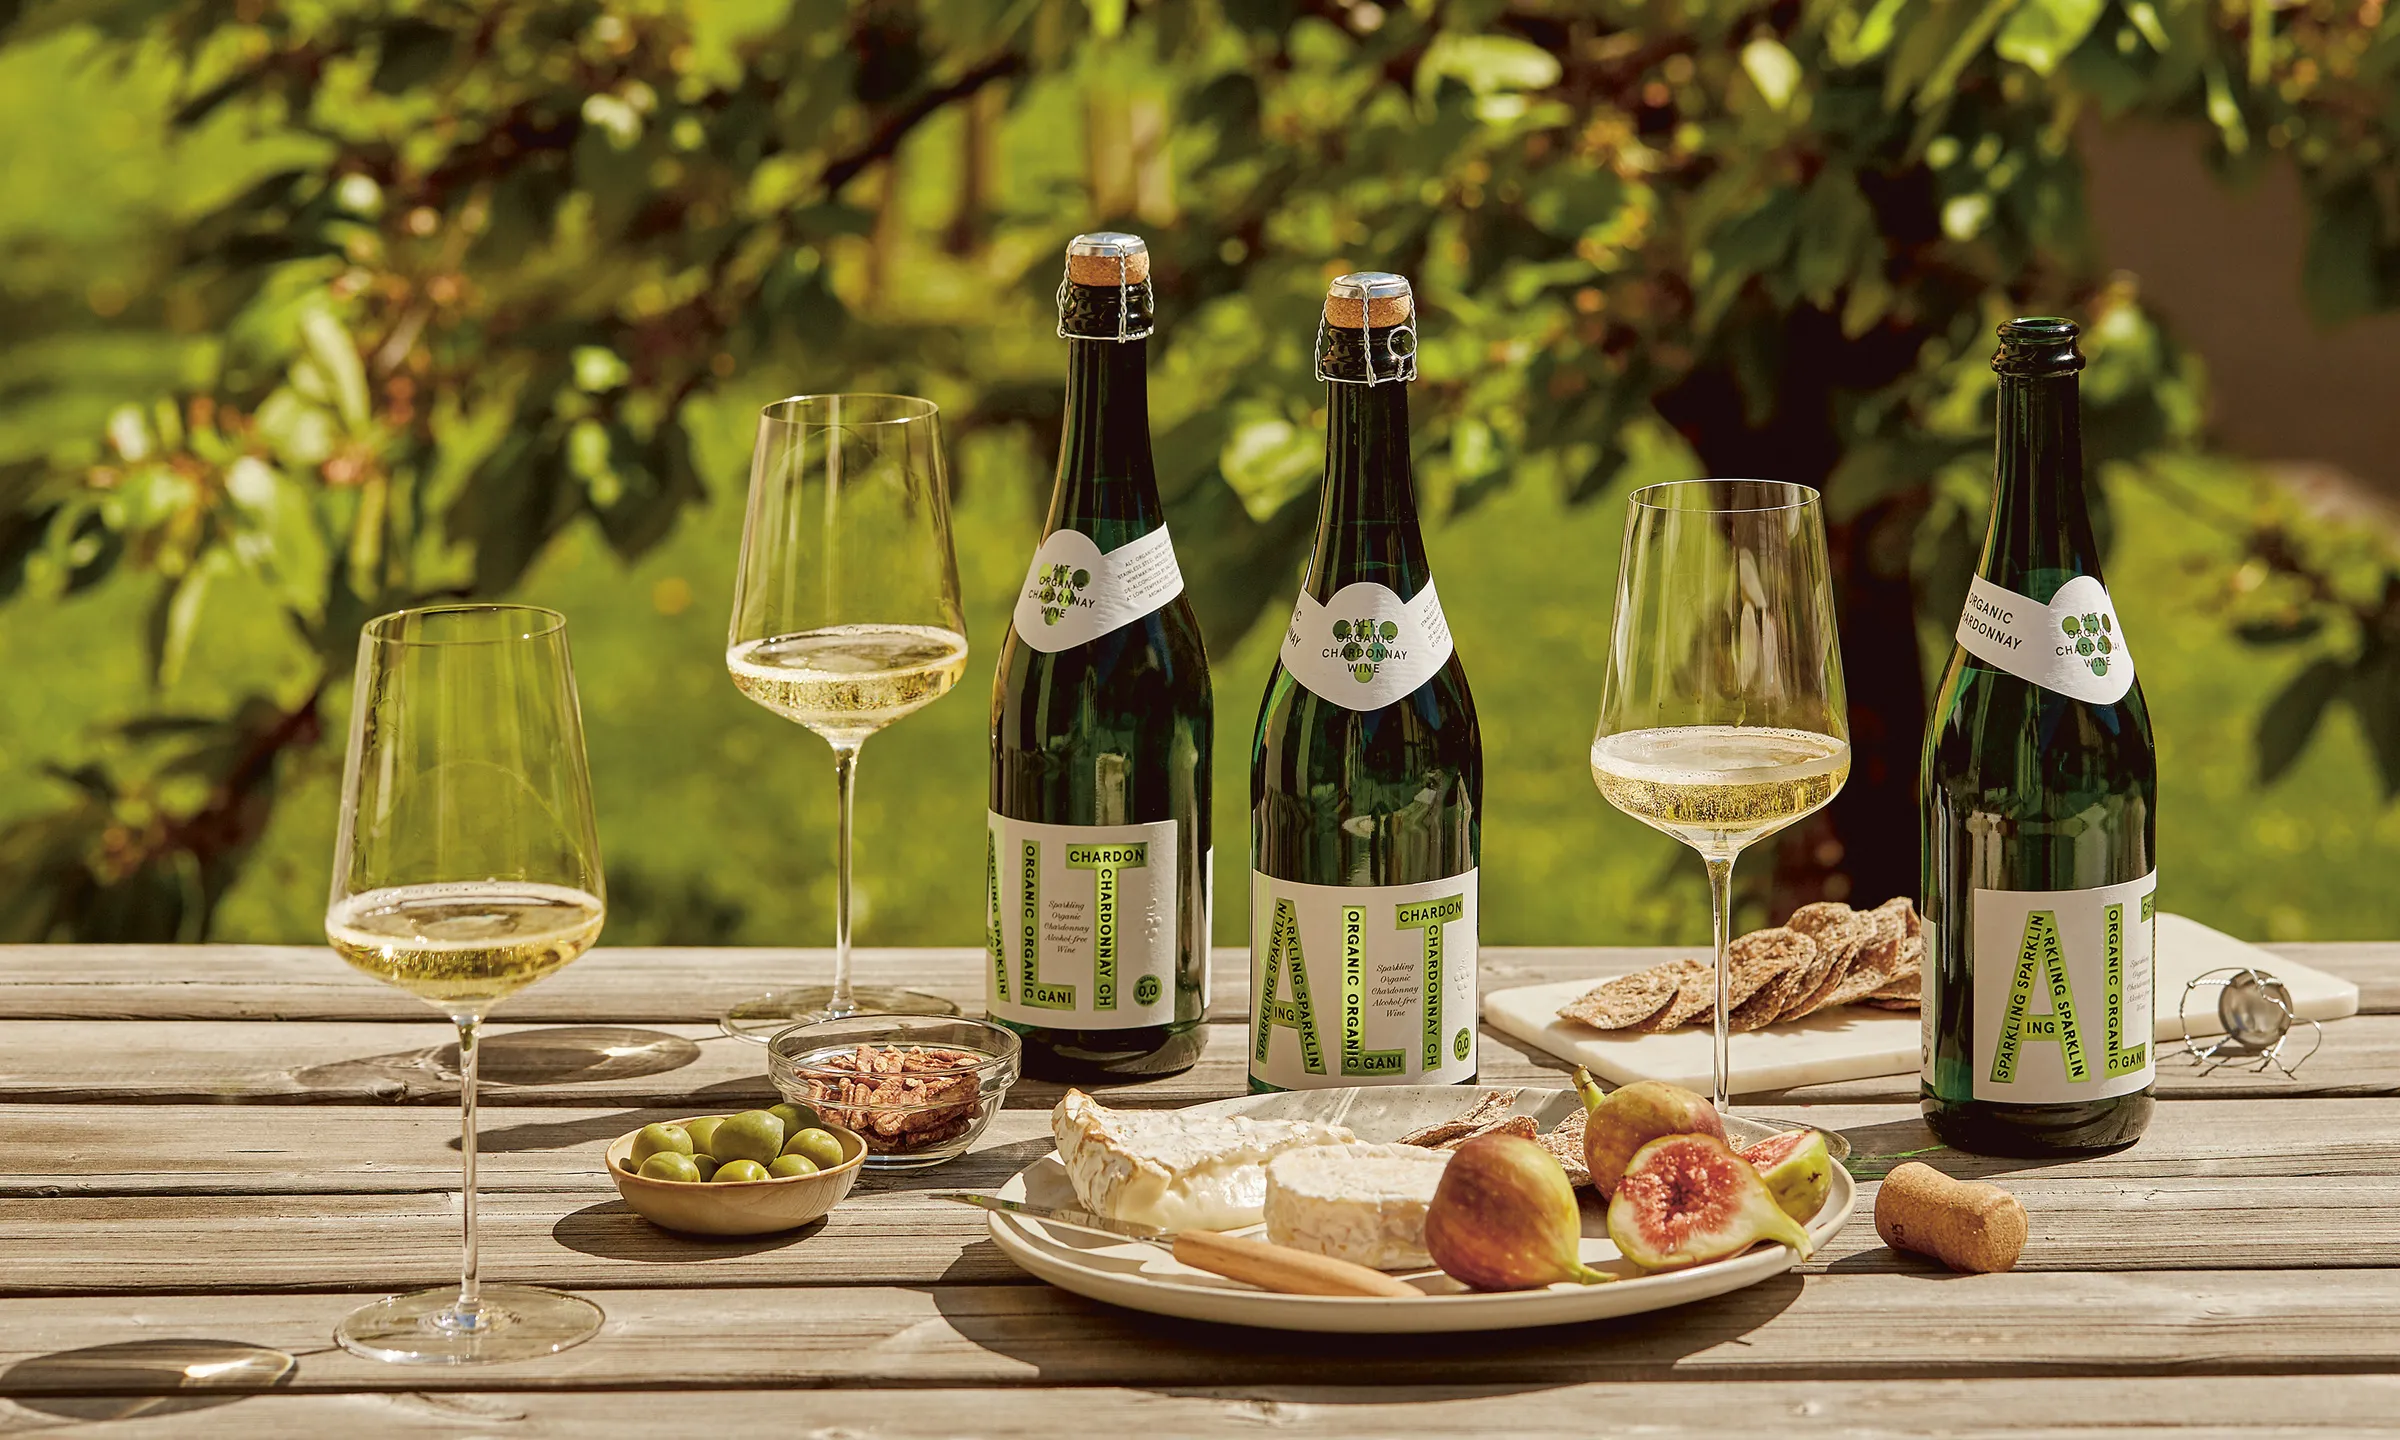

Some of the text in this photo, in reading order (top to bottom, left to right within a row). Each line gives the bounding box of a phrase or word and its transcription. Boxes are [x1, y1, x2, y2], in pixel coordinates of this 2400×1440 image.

[1053, 564, 1072, 575] ALT.
[1039, 576, 1084, 592] ORGANIC
[1028, 590, 1096, 609] CHARDONNAY
[1041, 606, 1067, 618] WINE
[1969, 592, 2014, 625] ORGANIC
[1353, 618, 1378, 628] ALT.
[1336, 633, 1394, 644] ORGANIC
[1322, 648, 1408, 660] CHARDONNAY
[1347, 663, 1380, 674] WINE
[2083, 656, 2112, 668] WINE
[1069, 849, 1144, 863] CHARDON
[1048, 900, 1085, 911] Sparkling
[1399, 900, 1462, 923] CHARDON
[1024, 845, 1036, 999] ORGANIC ORGANIC
[1051, 911, 1081, 922] Organic
[1043, 922, 1090, 934] Chardonnay
[1099, 868, 1113, 1007] CHARDONNAY CH
[1057, 945, 1076, 953] Wine
[1376, 962, 1415, 974] Sparkling
[1258, 902, 1287, 1058] SPARKLING SPARKLIN
[1380, 974, 1411, 985] Organic
[1346, 911, 1360, 1068] ORGANIC ORGANIC
[1371, 986, 1419, 995] Chardonnay
[1427, 925, 1439, 1066] CHARDONNAY CH
[2108, 909, 2119, 1070] ORGANIC ORGANIC
[1037, 990, 1071, 1004] GANI
[1372, 996, 1417, 1007] Alcohol-free
[1997, 915, 2045, 1079] SPARKLING SPARKLIN
[1274, 1006, 1295, 1022] ING
[1386, 1009, 1406, 1017] Wine
[1296, 991, 1320, 1068] SPARKLIN
[2026, 1021, 2055, 1034] ING
[2057, 1000, 2085, 1077] SPARKLIN
[1363, 1056, 1402, 1070] GANI
[2121, 1050, 2145, 1068] GANI
